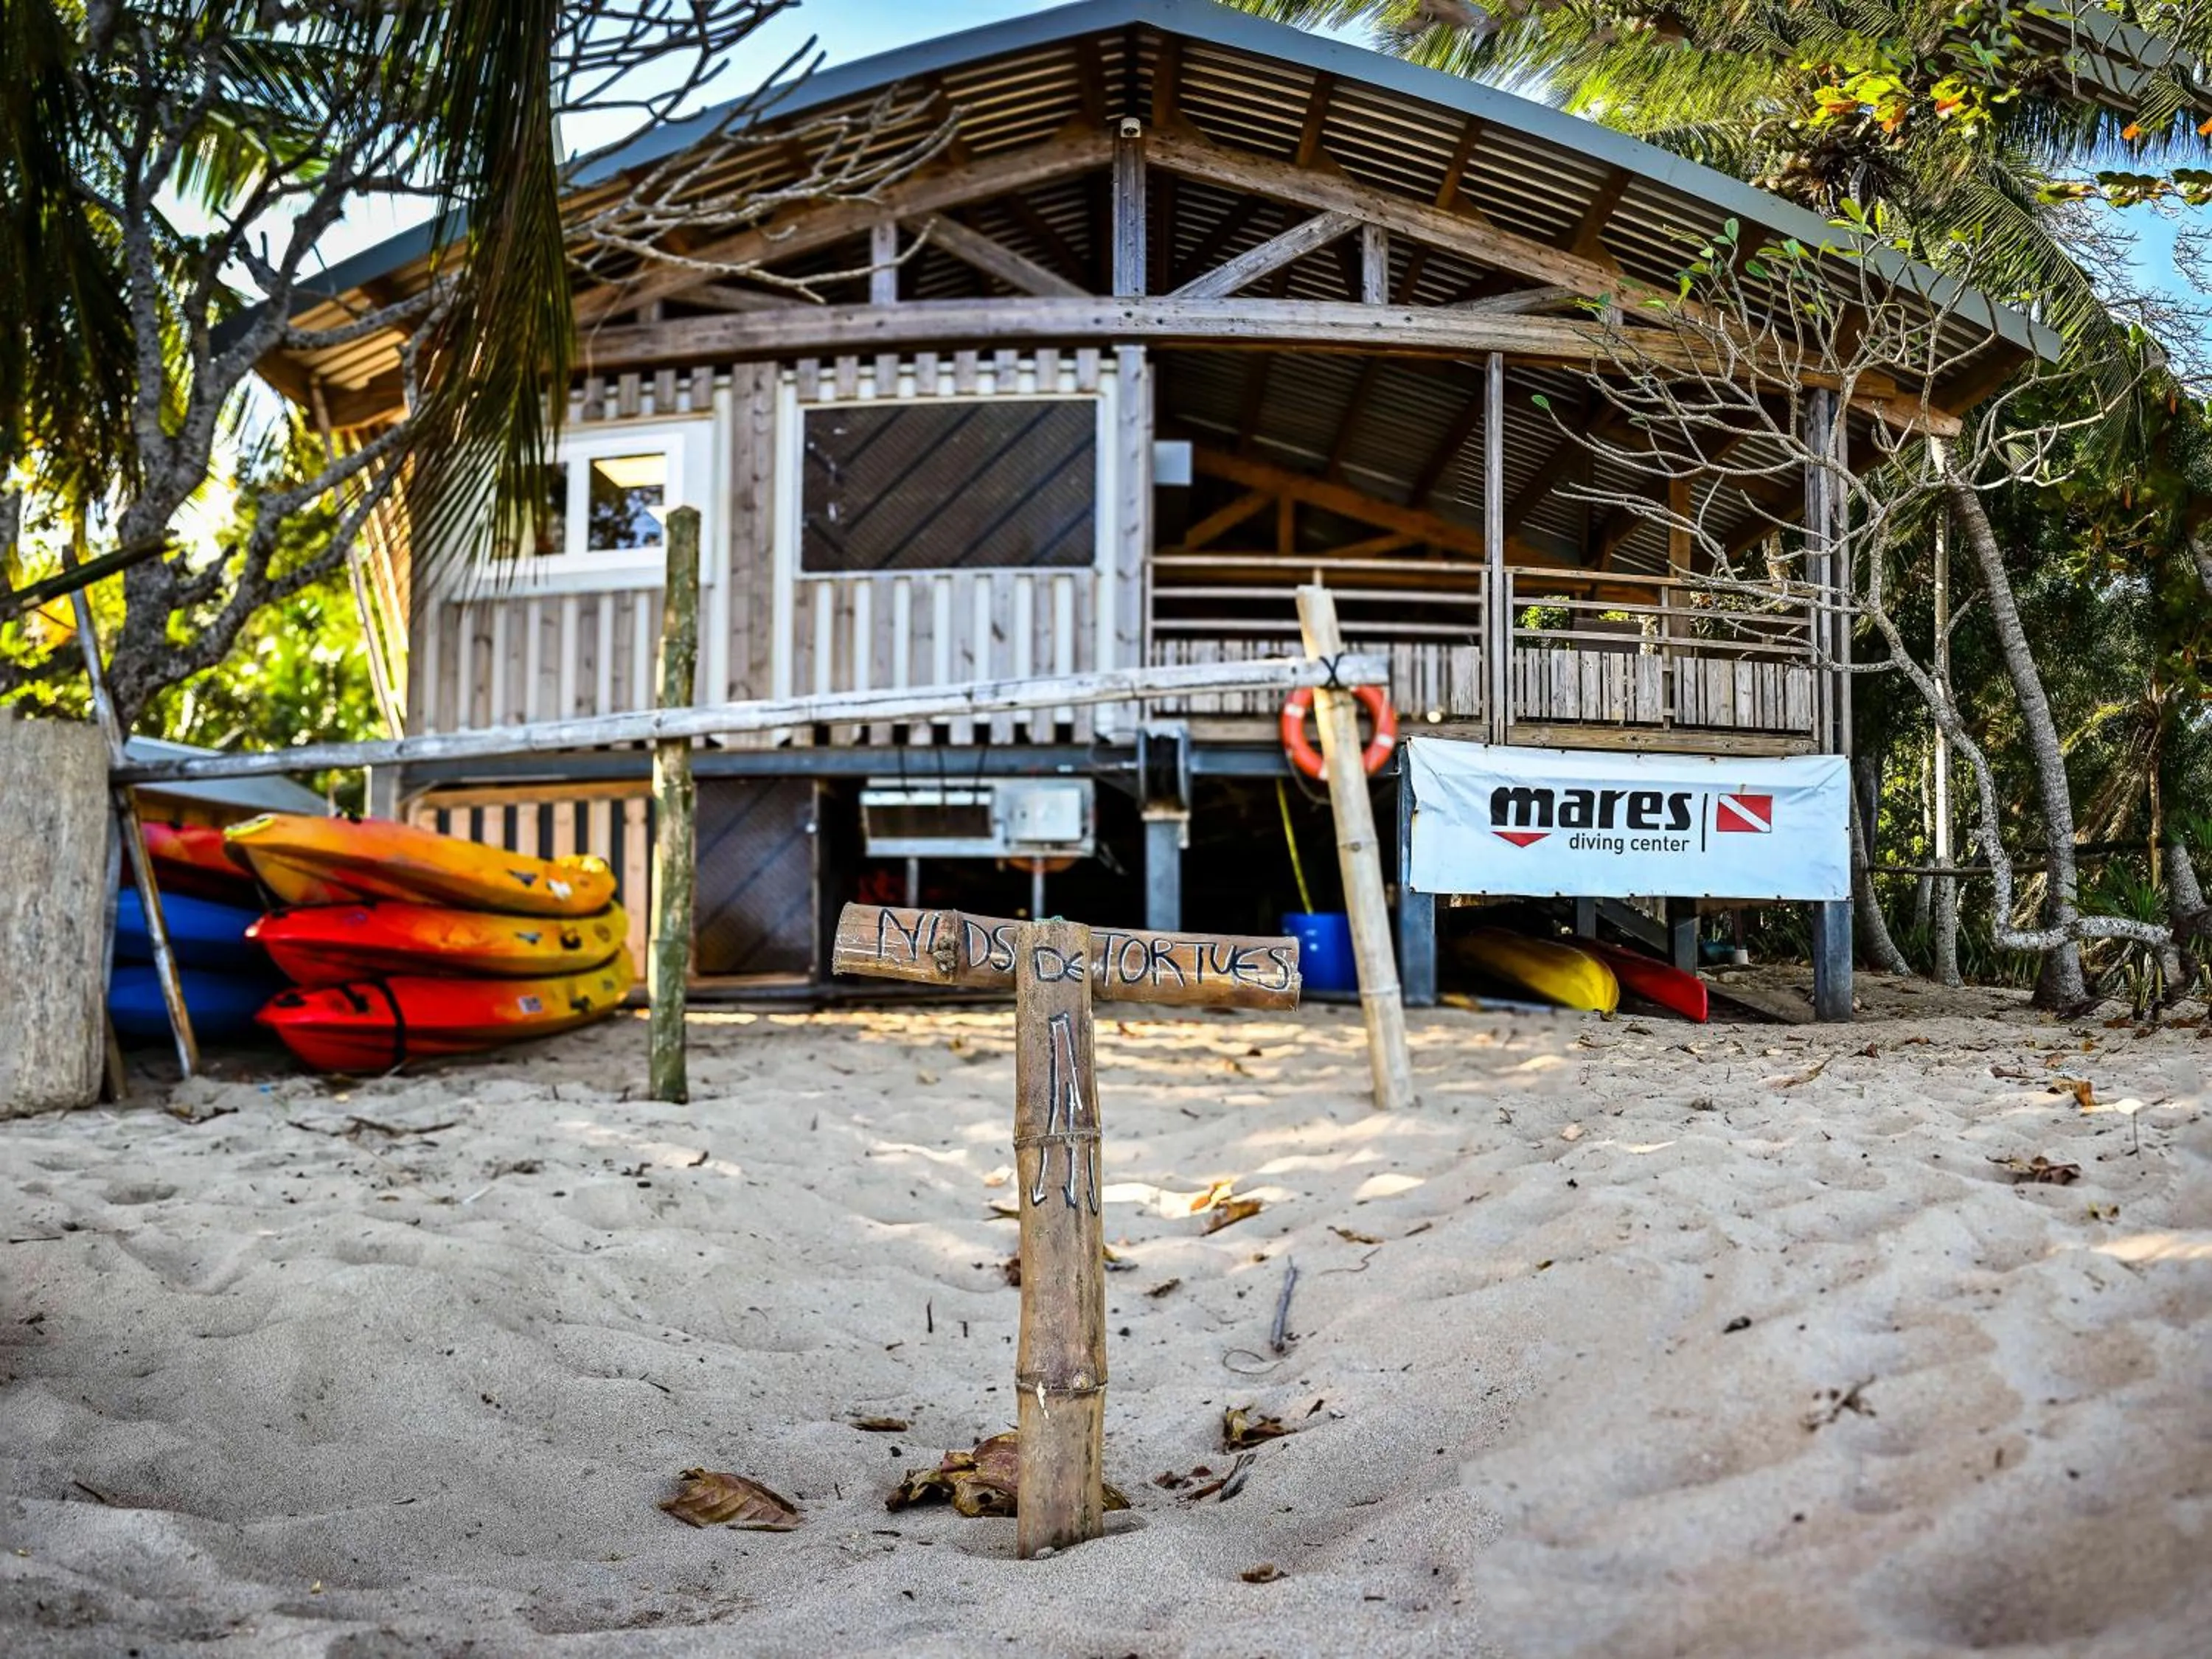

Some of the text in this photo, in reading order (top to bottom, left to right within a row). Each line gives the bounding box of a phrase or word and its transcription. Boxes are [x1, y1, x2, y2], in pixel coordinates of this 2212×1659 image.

[1490, 786, 1692, 830] mares
[1569, 832, 1691, 855] diving center
[877, 908, 1016, 972] NIDS
[1091, 931, 1293, 990] TORTUES
